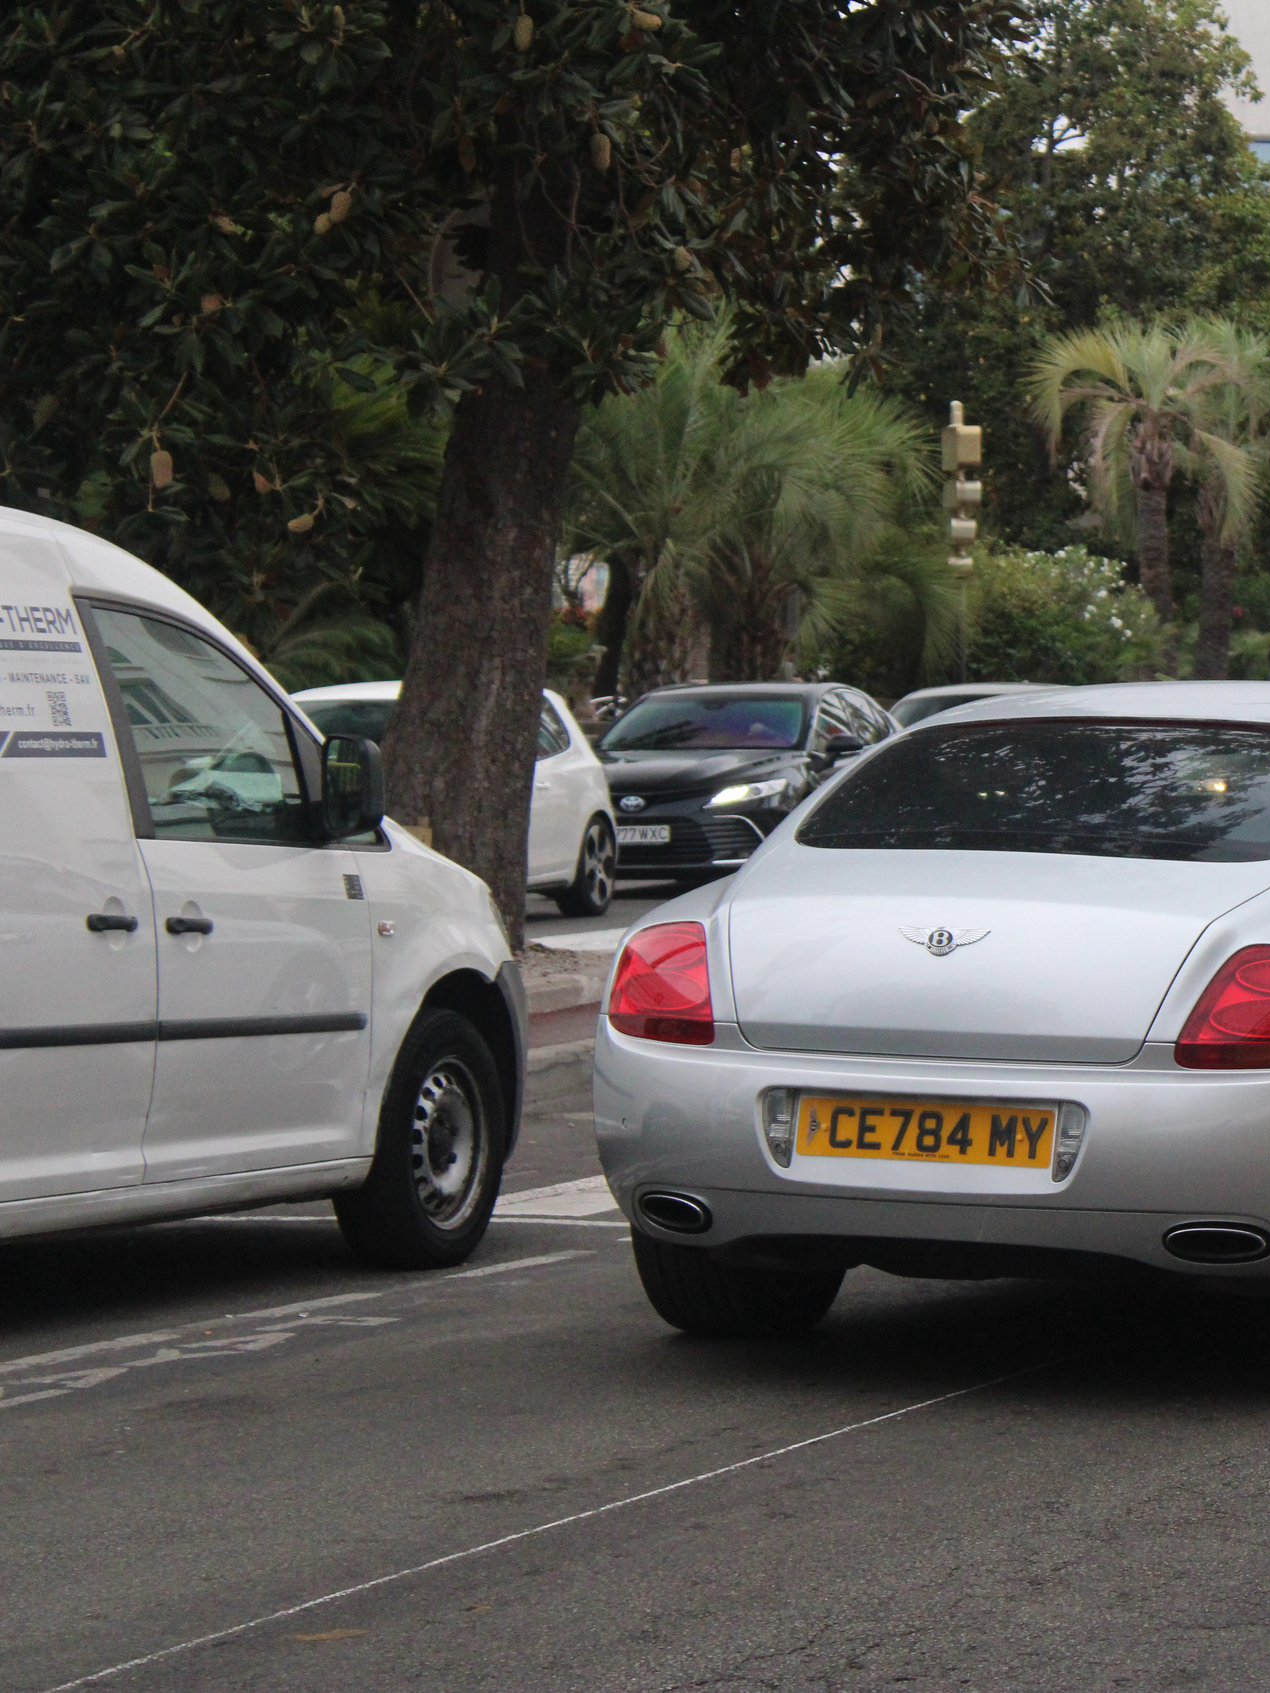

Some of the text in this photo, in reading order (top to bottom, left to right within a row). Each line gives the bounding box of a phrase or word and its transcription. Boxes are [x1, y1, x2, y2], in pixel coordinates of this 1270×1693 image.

[8, 672, 68, 685] MAINTENANCE
[74, 674, 91, 685] SAV
[828, 1106, 1049, 1160] CE784 MY
